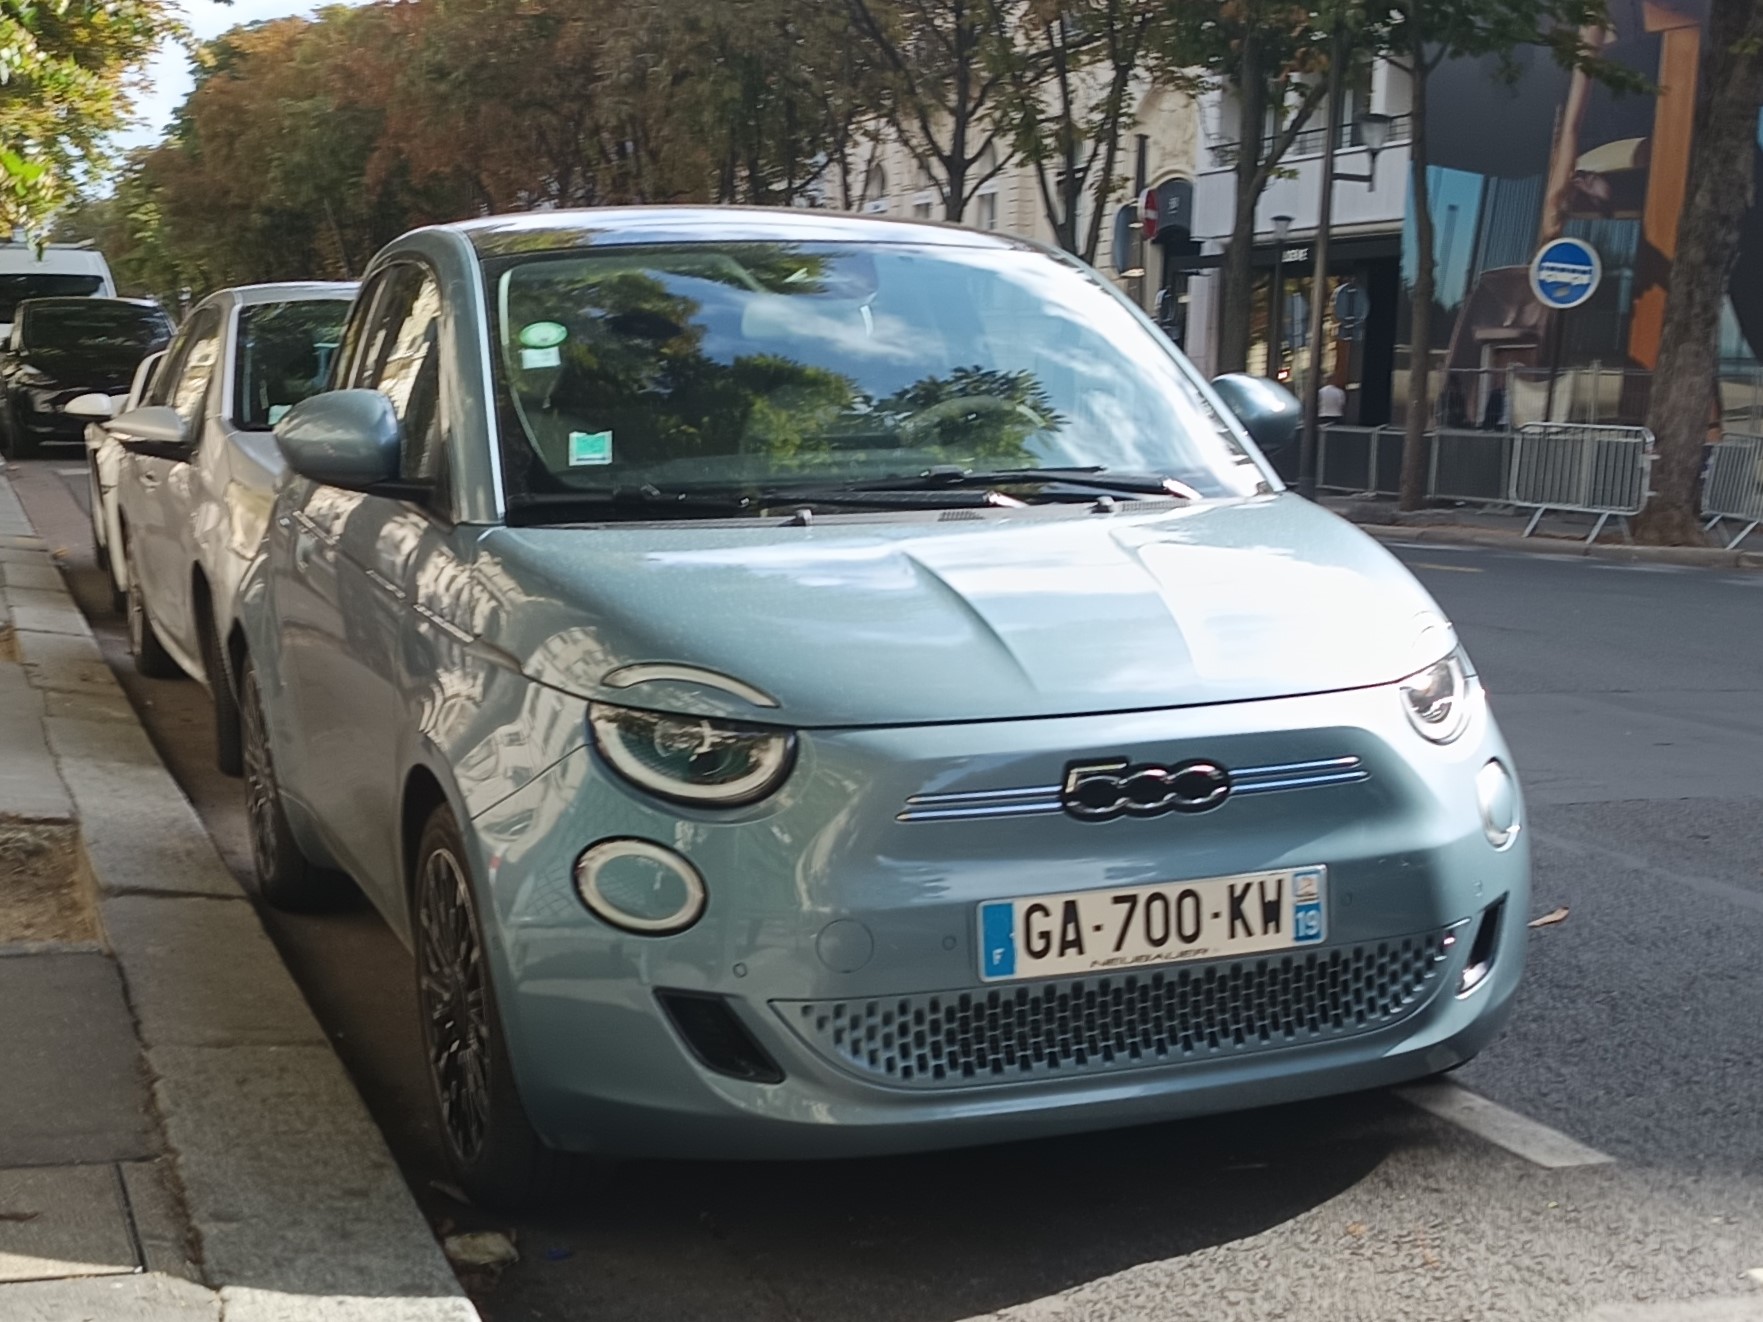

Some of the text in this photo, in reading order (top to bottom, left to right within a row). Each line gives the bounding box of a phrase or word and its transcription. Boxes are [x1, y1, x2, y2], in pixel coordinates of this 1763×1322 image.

[1065, 758, 1230, 820] 500
[1022, 878, 1284, 959] GA-700-KW
[1296, 909, 1320, 937] 19
[992, 947, 1005, 966] F
